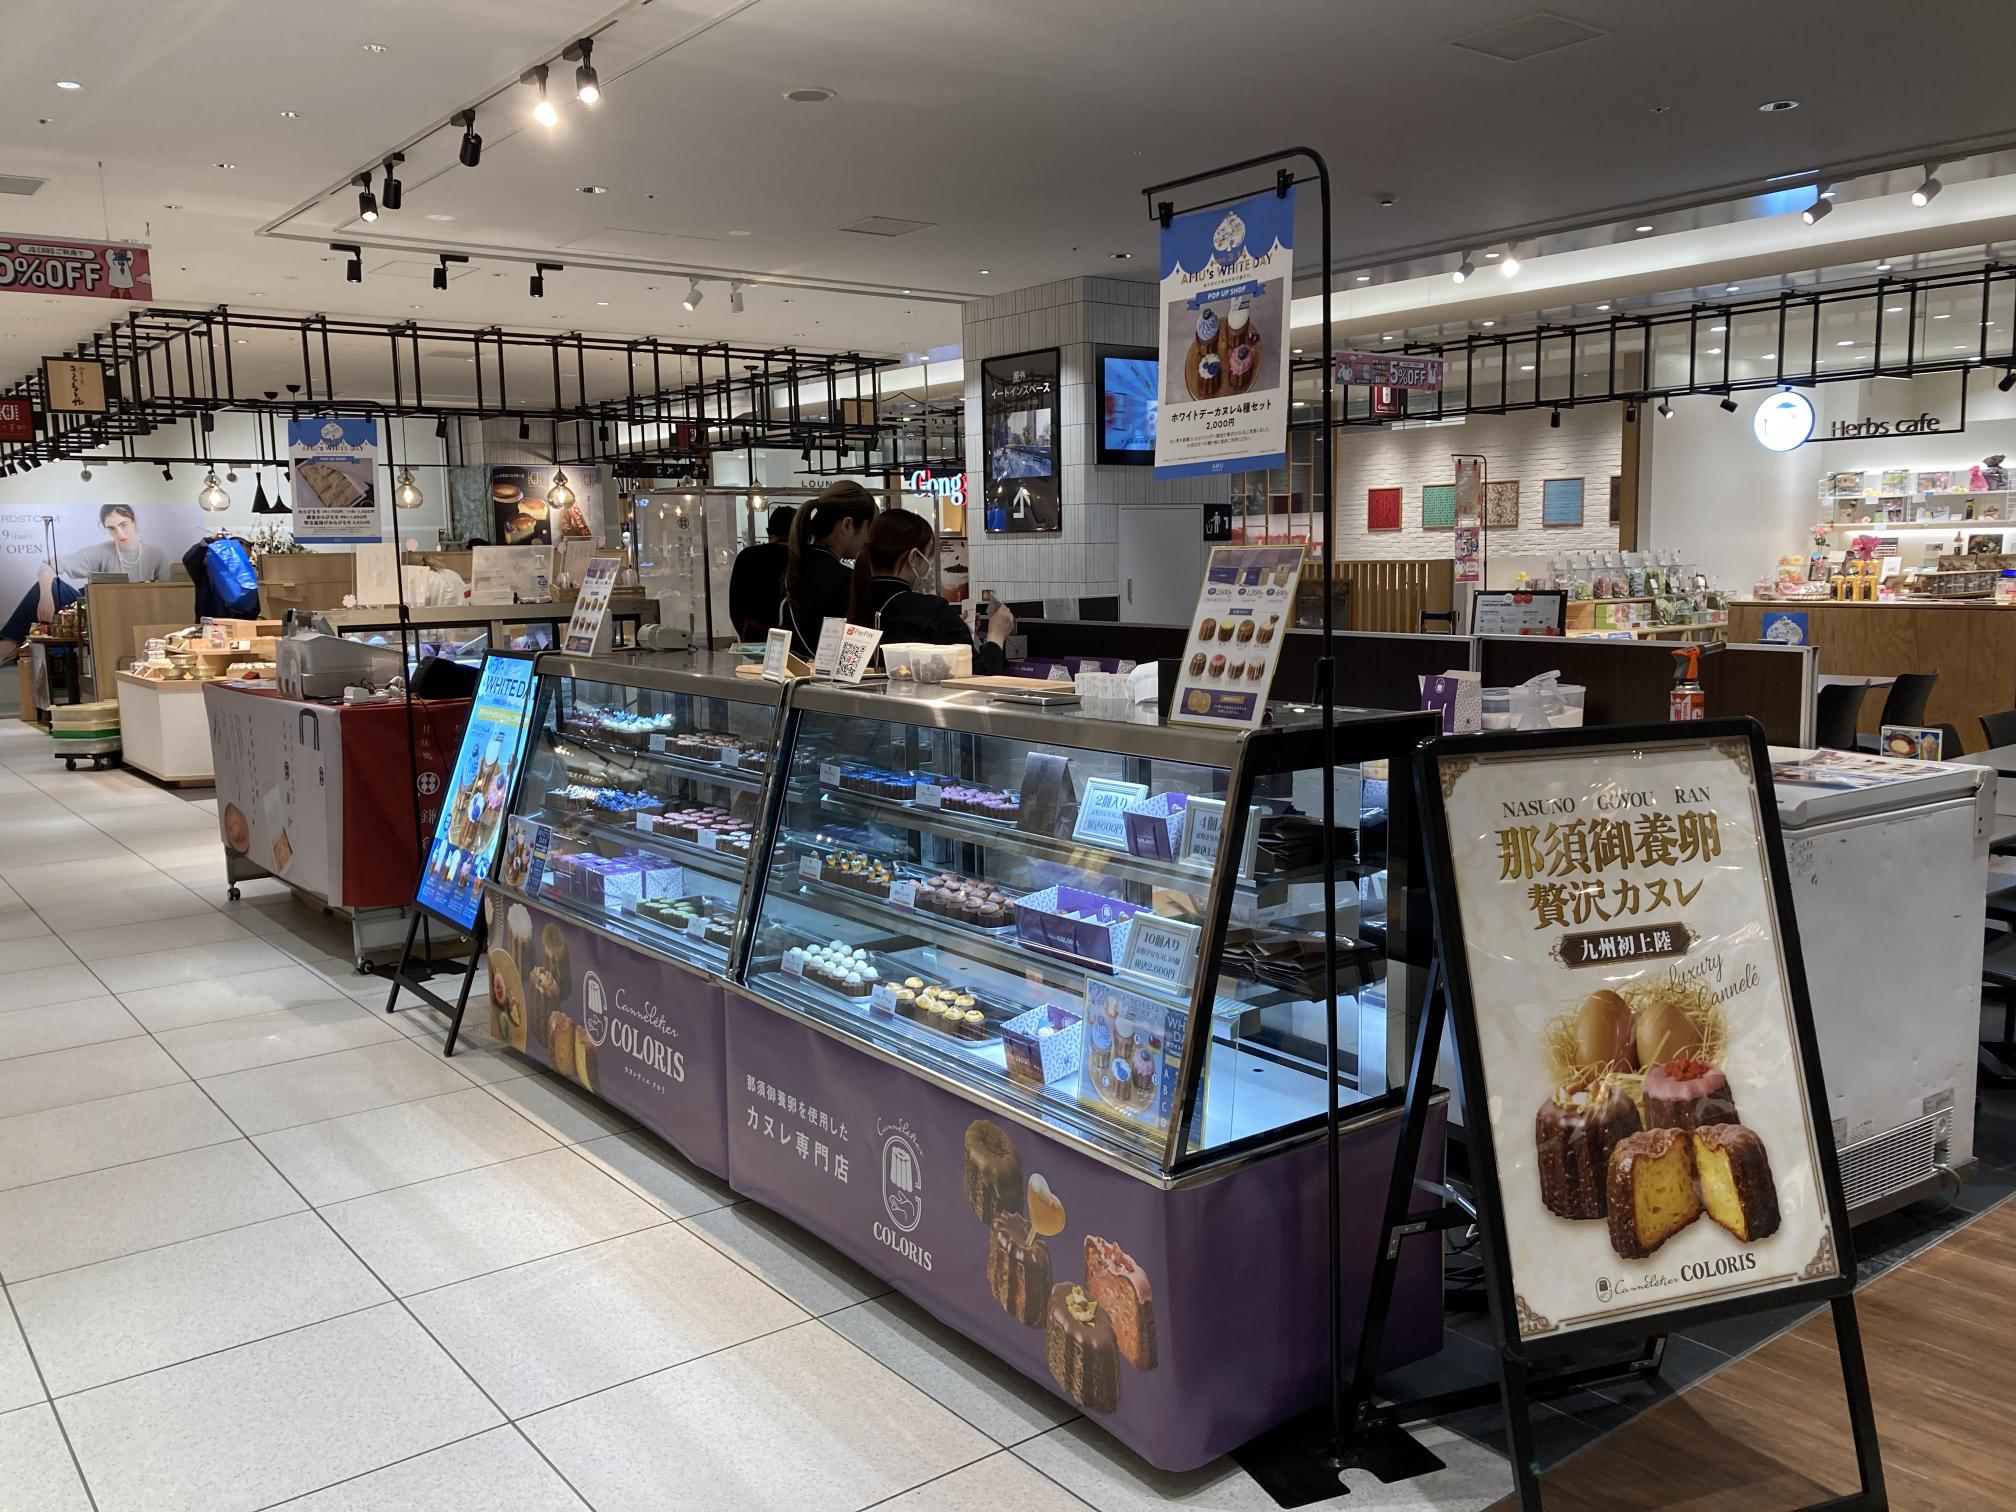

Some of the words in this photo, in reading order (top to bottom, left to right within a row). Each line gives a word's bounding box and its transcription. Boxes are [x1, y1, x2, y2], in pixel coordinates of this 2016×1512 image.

[1207, 291, 1220, 300] POP
[1220, 288, 1230, 298] UP
[1230, 285, 1246, 296] SHOP
[1390, 360, 1427, 385] 5%OFF
[991, 382, 1050, 400] イートインスペース
[1171, 399, 1272, 423] ホワイトデーカヌレ4種セット
[1206, 418, 1235, 430] 2,000円
[1831, 418, 1889, 438] Herbs
[1895, 413, 1940, 433] cafe
[801, 480, 834, 488] LOUN
[7, 544, 43, 554] OPEN
[1096, 794, 1128, 810] 2個入り
[1502, 797, 1575, 818] NASUNO
[1675, 786, 1711, 804] RAN
[1494, 810, 1722, 881] 那須御養卵
[1527, 877, 1705, 930] 贅沢カヌレ
[1144, 932, 1180, 951] 10個入り
[1580, 930, 1674, 962] 九州初上陸
[1698, 964, 1761, 1013] Cannelé
[610, 1018, 685, 1082] COLORIS
[746, 1074, 849, 1142] 那須御養卵を使用した
[747, 1106, 849, 1184] カヌレ専門店
[873, 1221, 932, 1272] COLORIS
[1680, 1253, 1756, 1282] COLORIS
